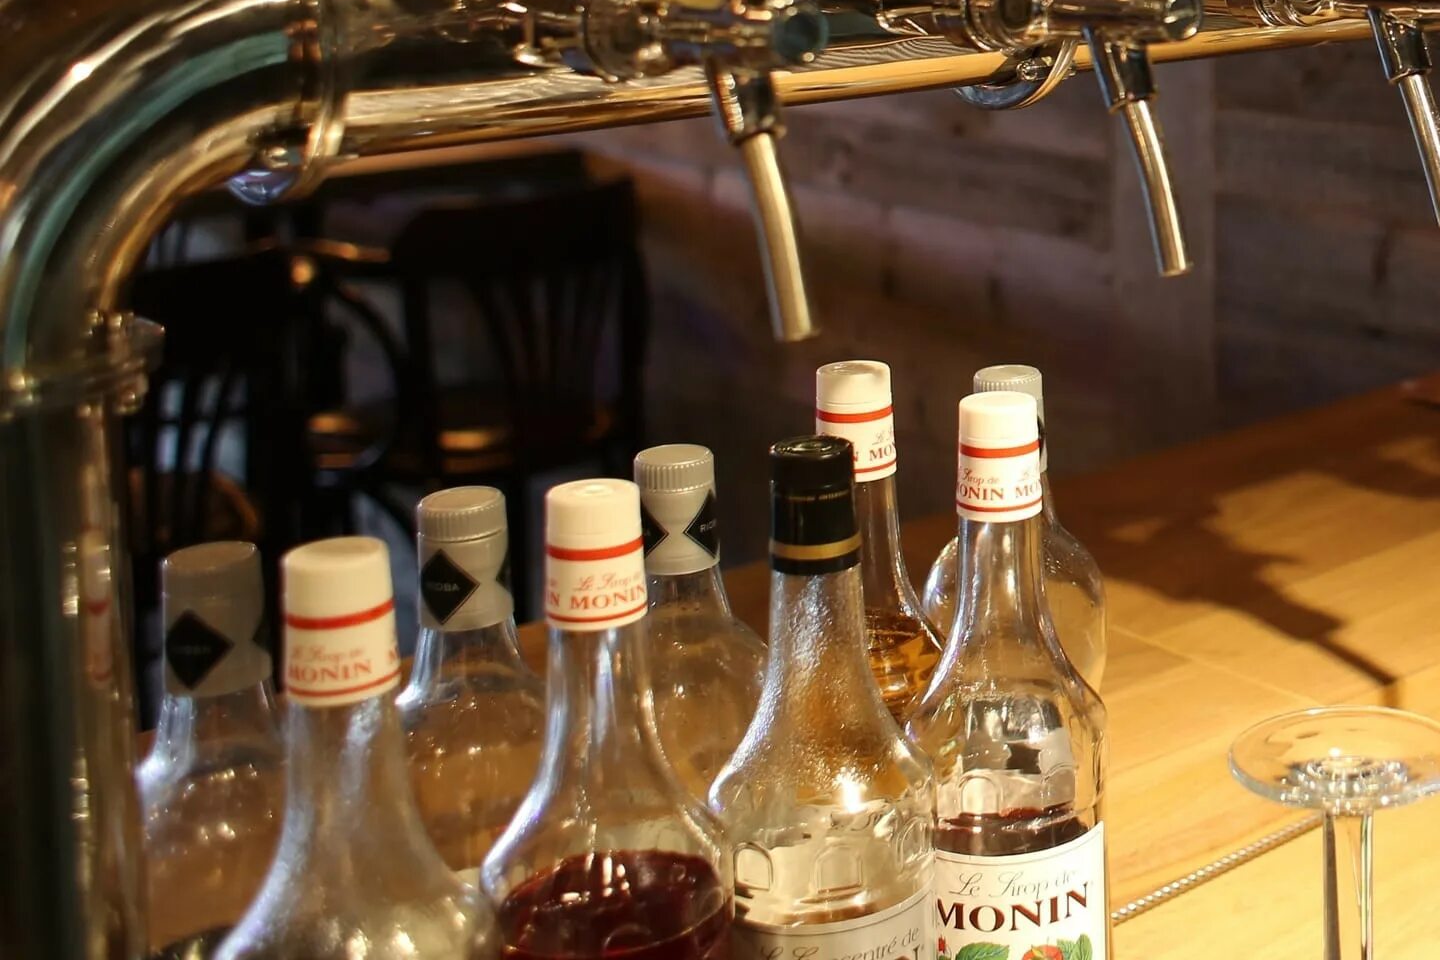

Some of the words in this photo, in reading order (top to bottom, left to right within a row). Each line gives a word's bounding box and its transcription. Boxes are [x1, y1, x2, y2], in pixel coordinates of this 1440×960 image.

[957, 483, 1005, 501] ONIN
[570, 584, 646, 610] MONIN
[949, 872, 983, 897] Le
[988, 871, 1051, 900] Sirop
[1054, 869, 1078, 887] de
[936, 881, 1089, 933] MONIN
[900, 926, 920, 948] de
